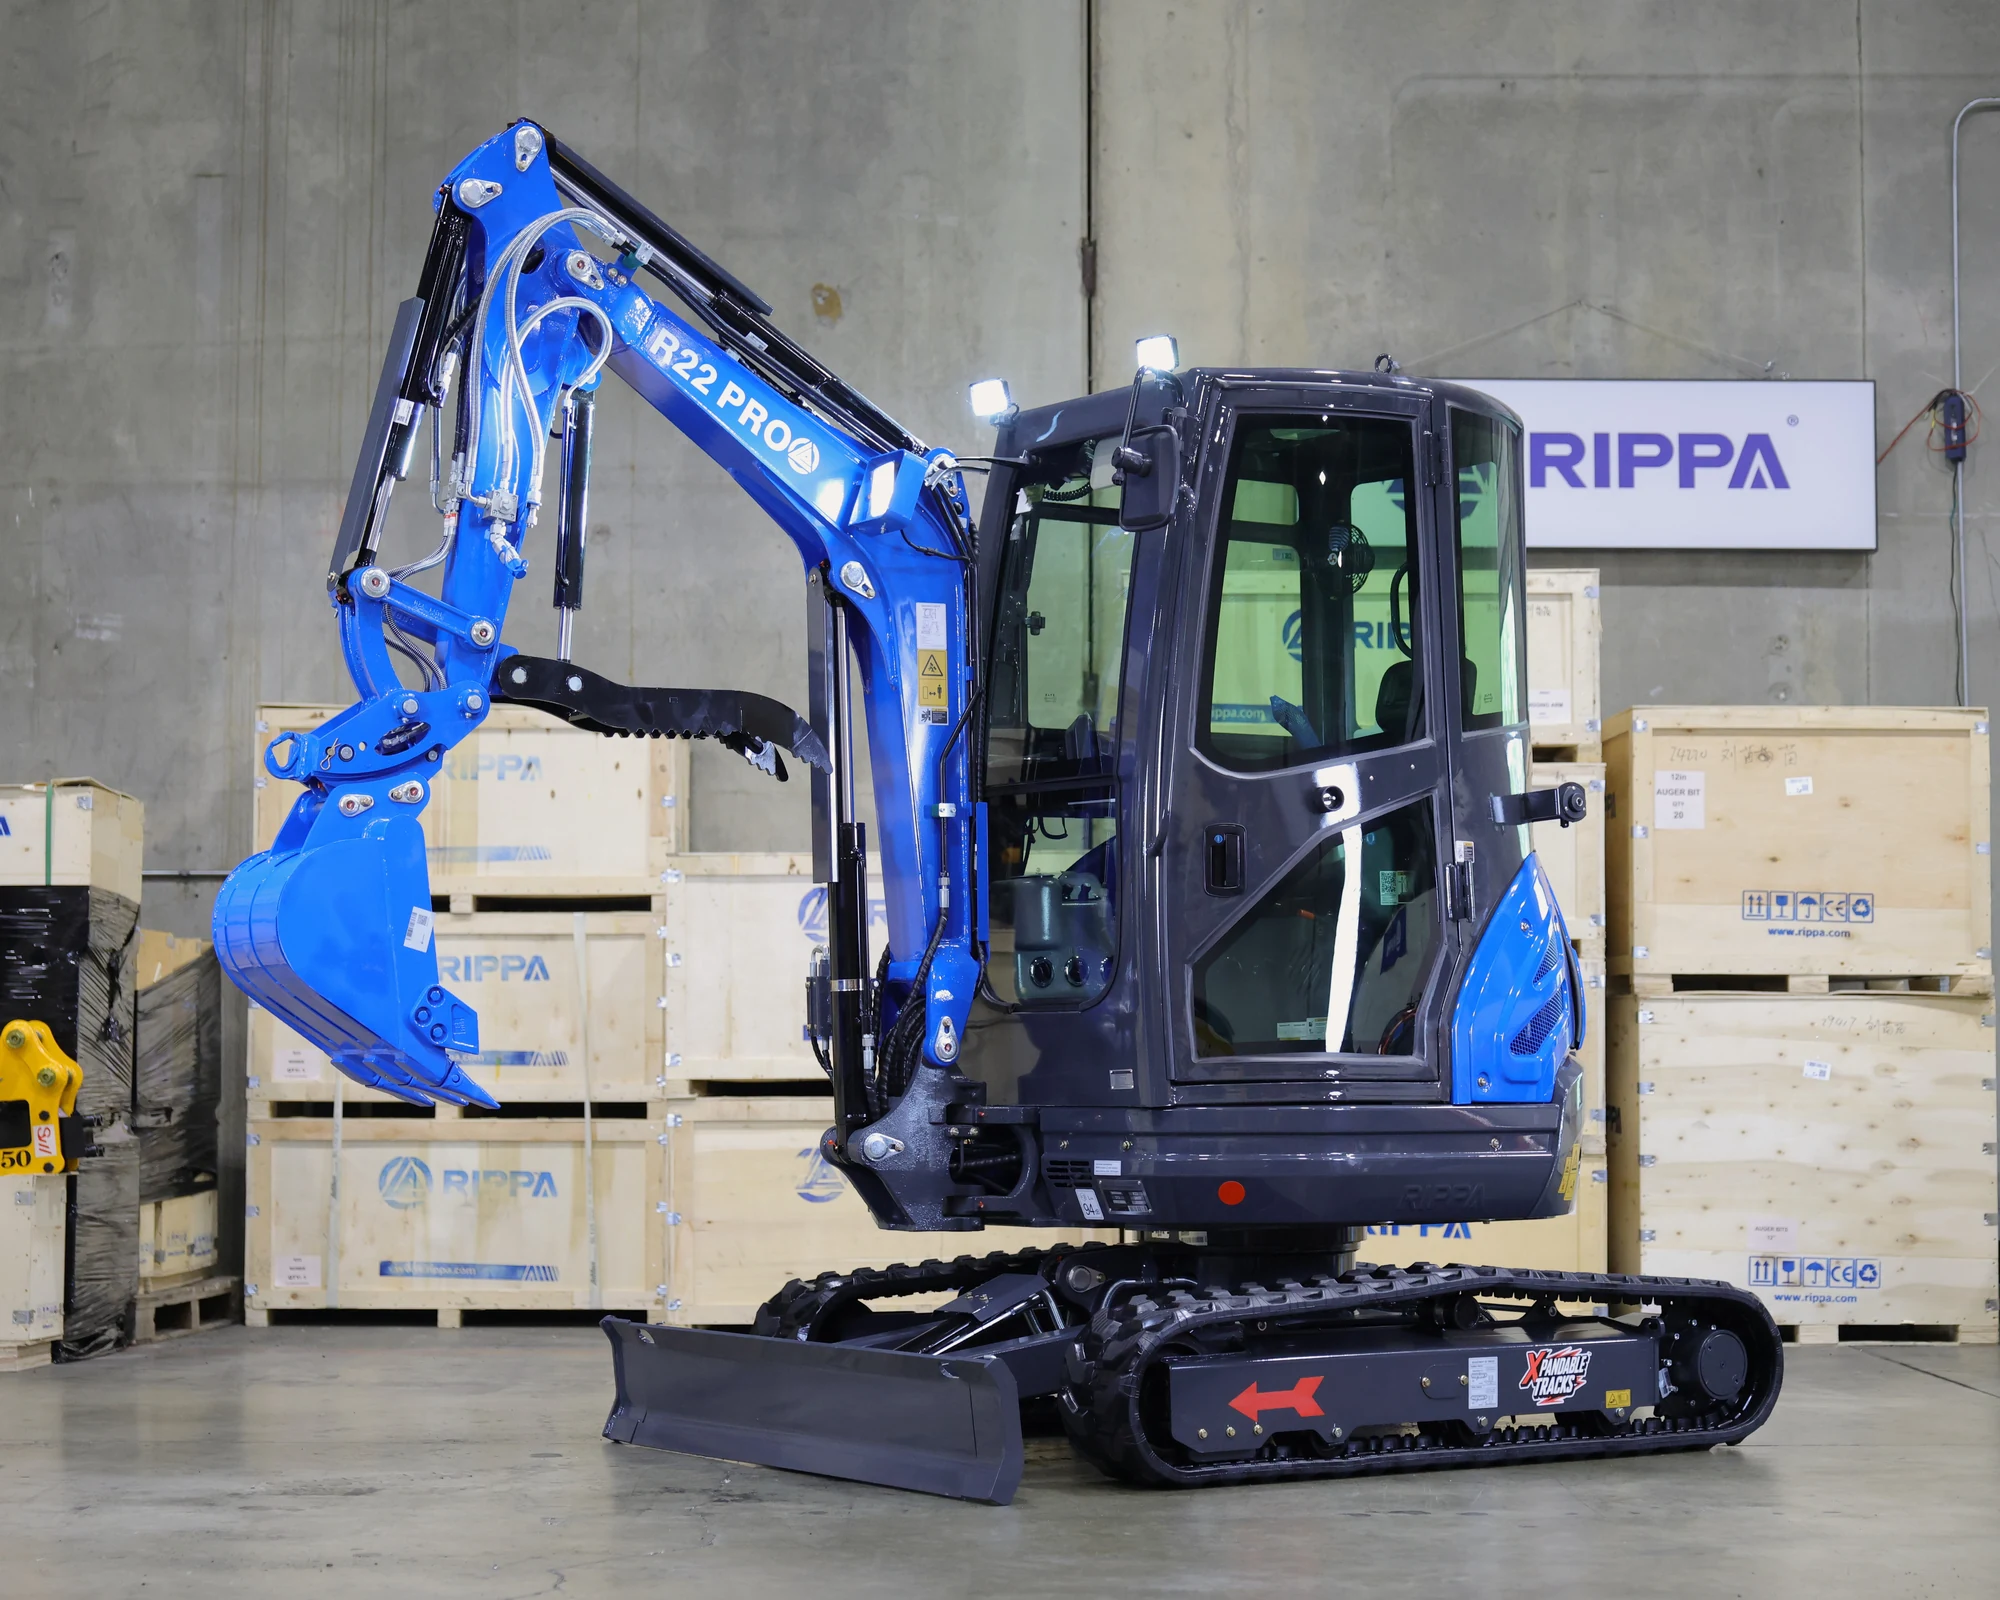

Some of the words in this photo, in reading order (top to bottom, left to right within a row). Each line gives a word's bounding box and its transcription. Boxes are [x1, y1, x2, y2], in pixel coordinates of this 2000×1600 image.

[649, 327, 719, 396] R22
[716, 380, 792, 453] PRO
[1530, 432, 1791, 489] RIPPA
[1671, 773, 1687, 781] 12in
[1656, 788, 1686, 796] AUGER
[1687, 788, 1701, 796] BIT
[1673, 811, 1684, 819] 20
[1768, 927, 1851, 940] www.rippa.com
[438, 954, 551, 982] RIPPA
[442, 1169, 559, 1198] RIPPA
[1082, 1202, 1096, 1216] 94
[1774, 1292, 1858, 1306] www.rippa.com
[1521, 1349, 1588, 1386] XPANDABLE
[1534, 1375, 1576, 1397] TRACKS
